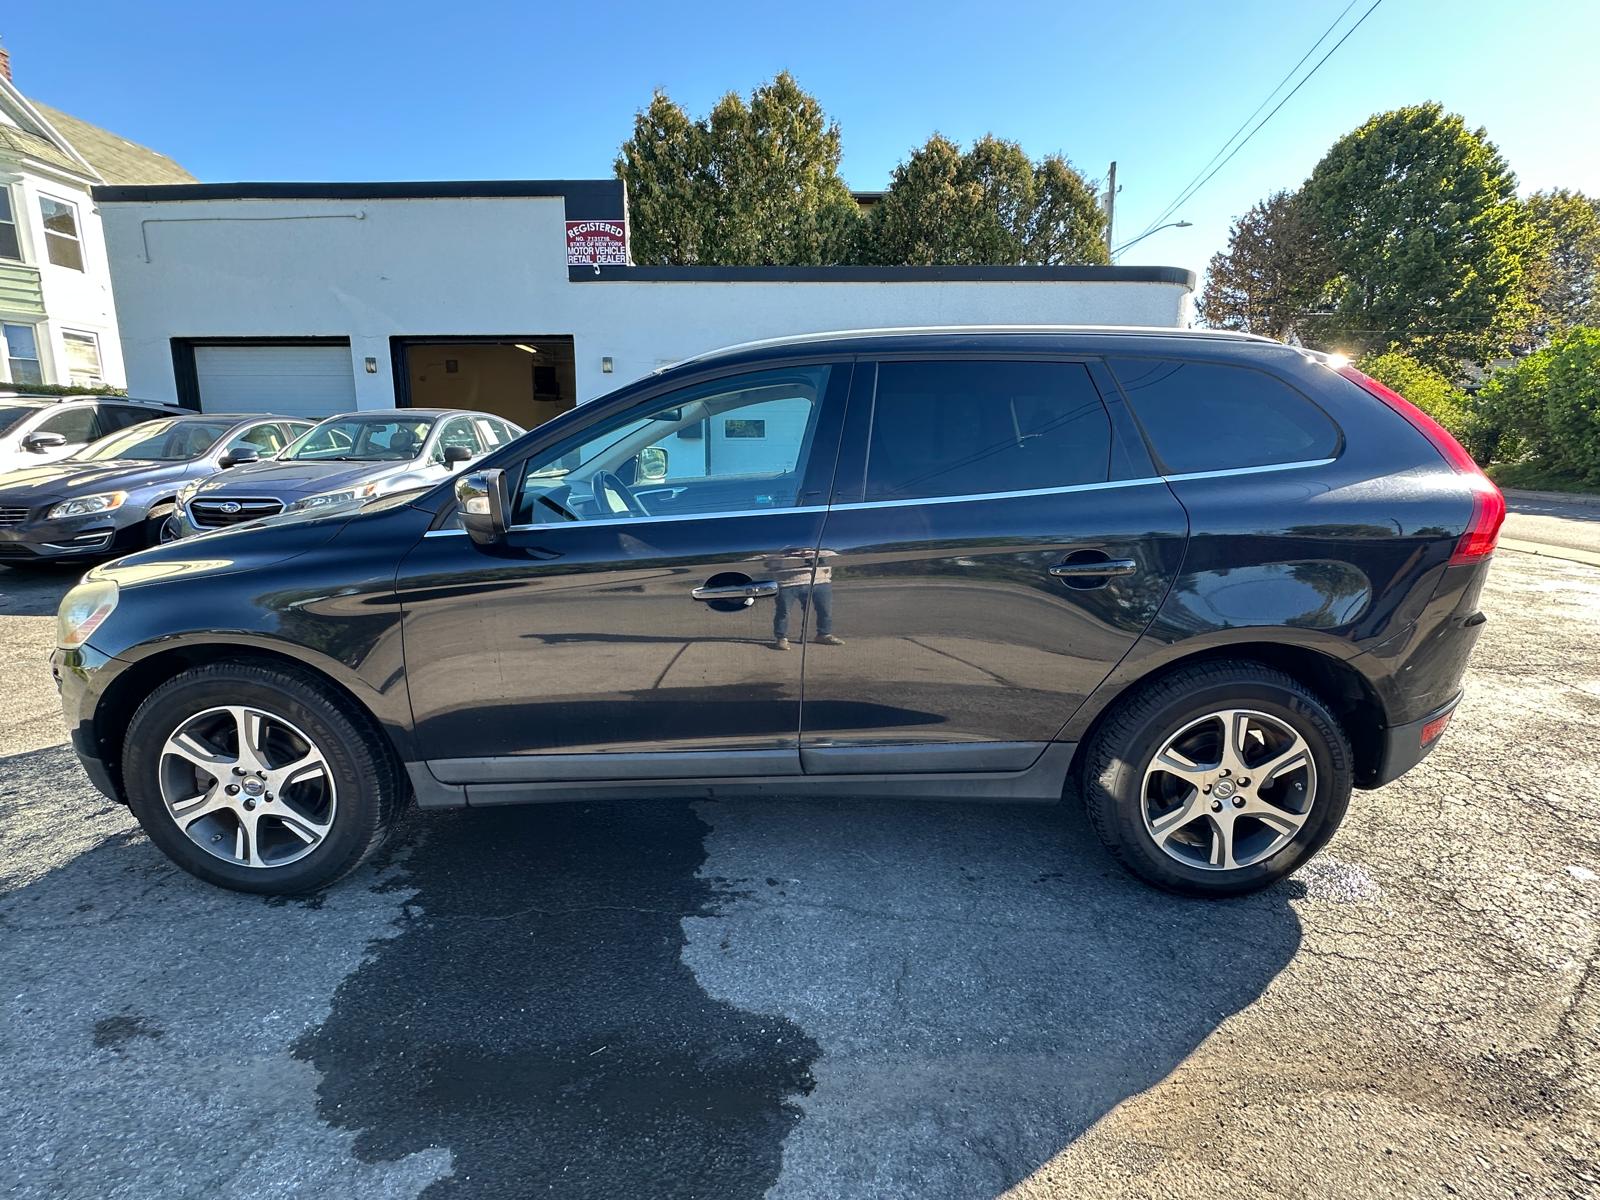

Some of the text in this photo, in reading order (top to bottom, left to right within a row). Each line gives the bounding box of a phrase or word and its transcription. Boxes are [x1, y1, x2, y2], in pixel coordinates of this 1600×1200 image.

[567, 222, 623, 238] REGISTERED
[568, 246, 626, 255] MOTOR VEHICLE
[568, 255, 626, 263] RETAIL DEALER
[1311, 715, 1345, 770] MICHELIN
